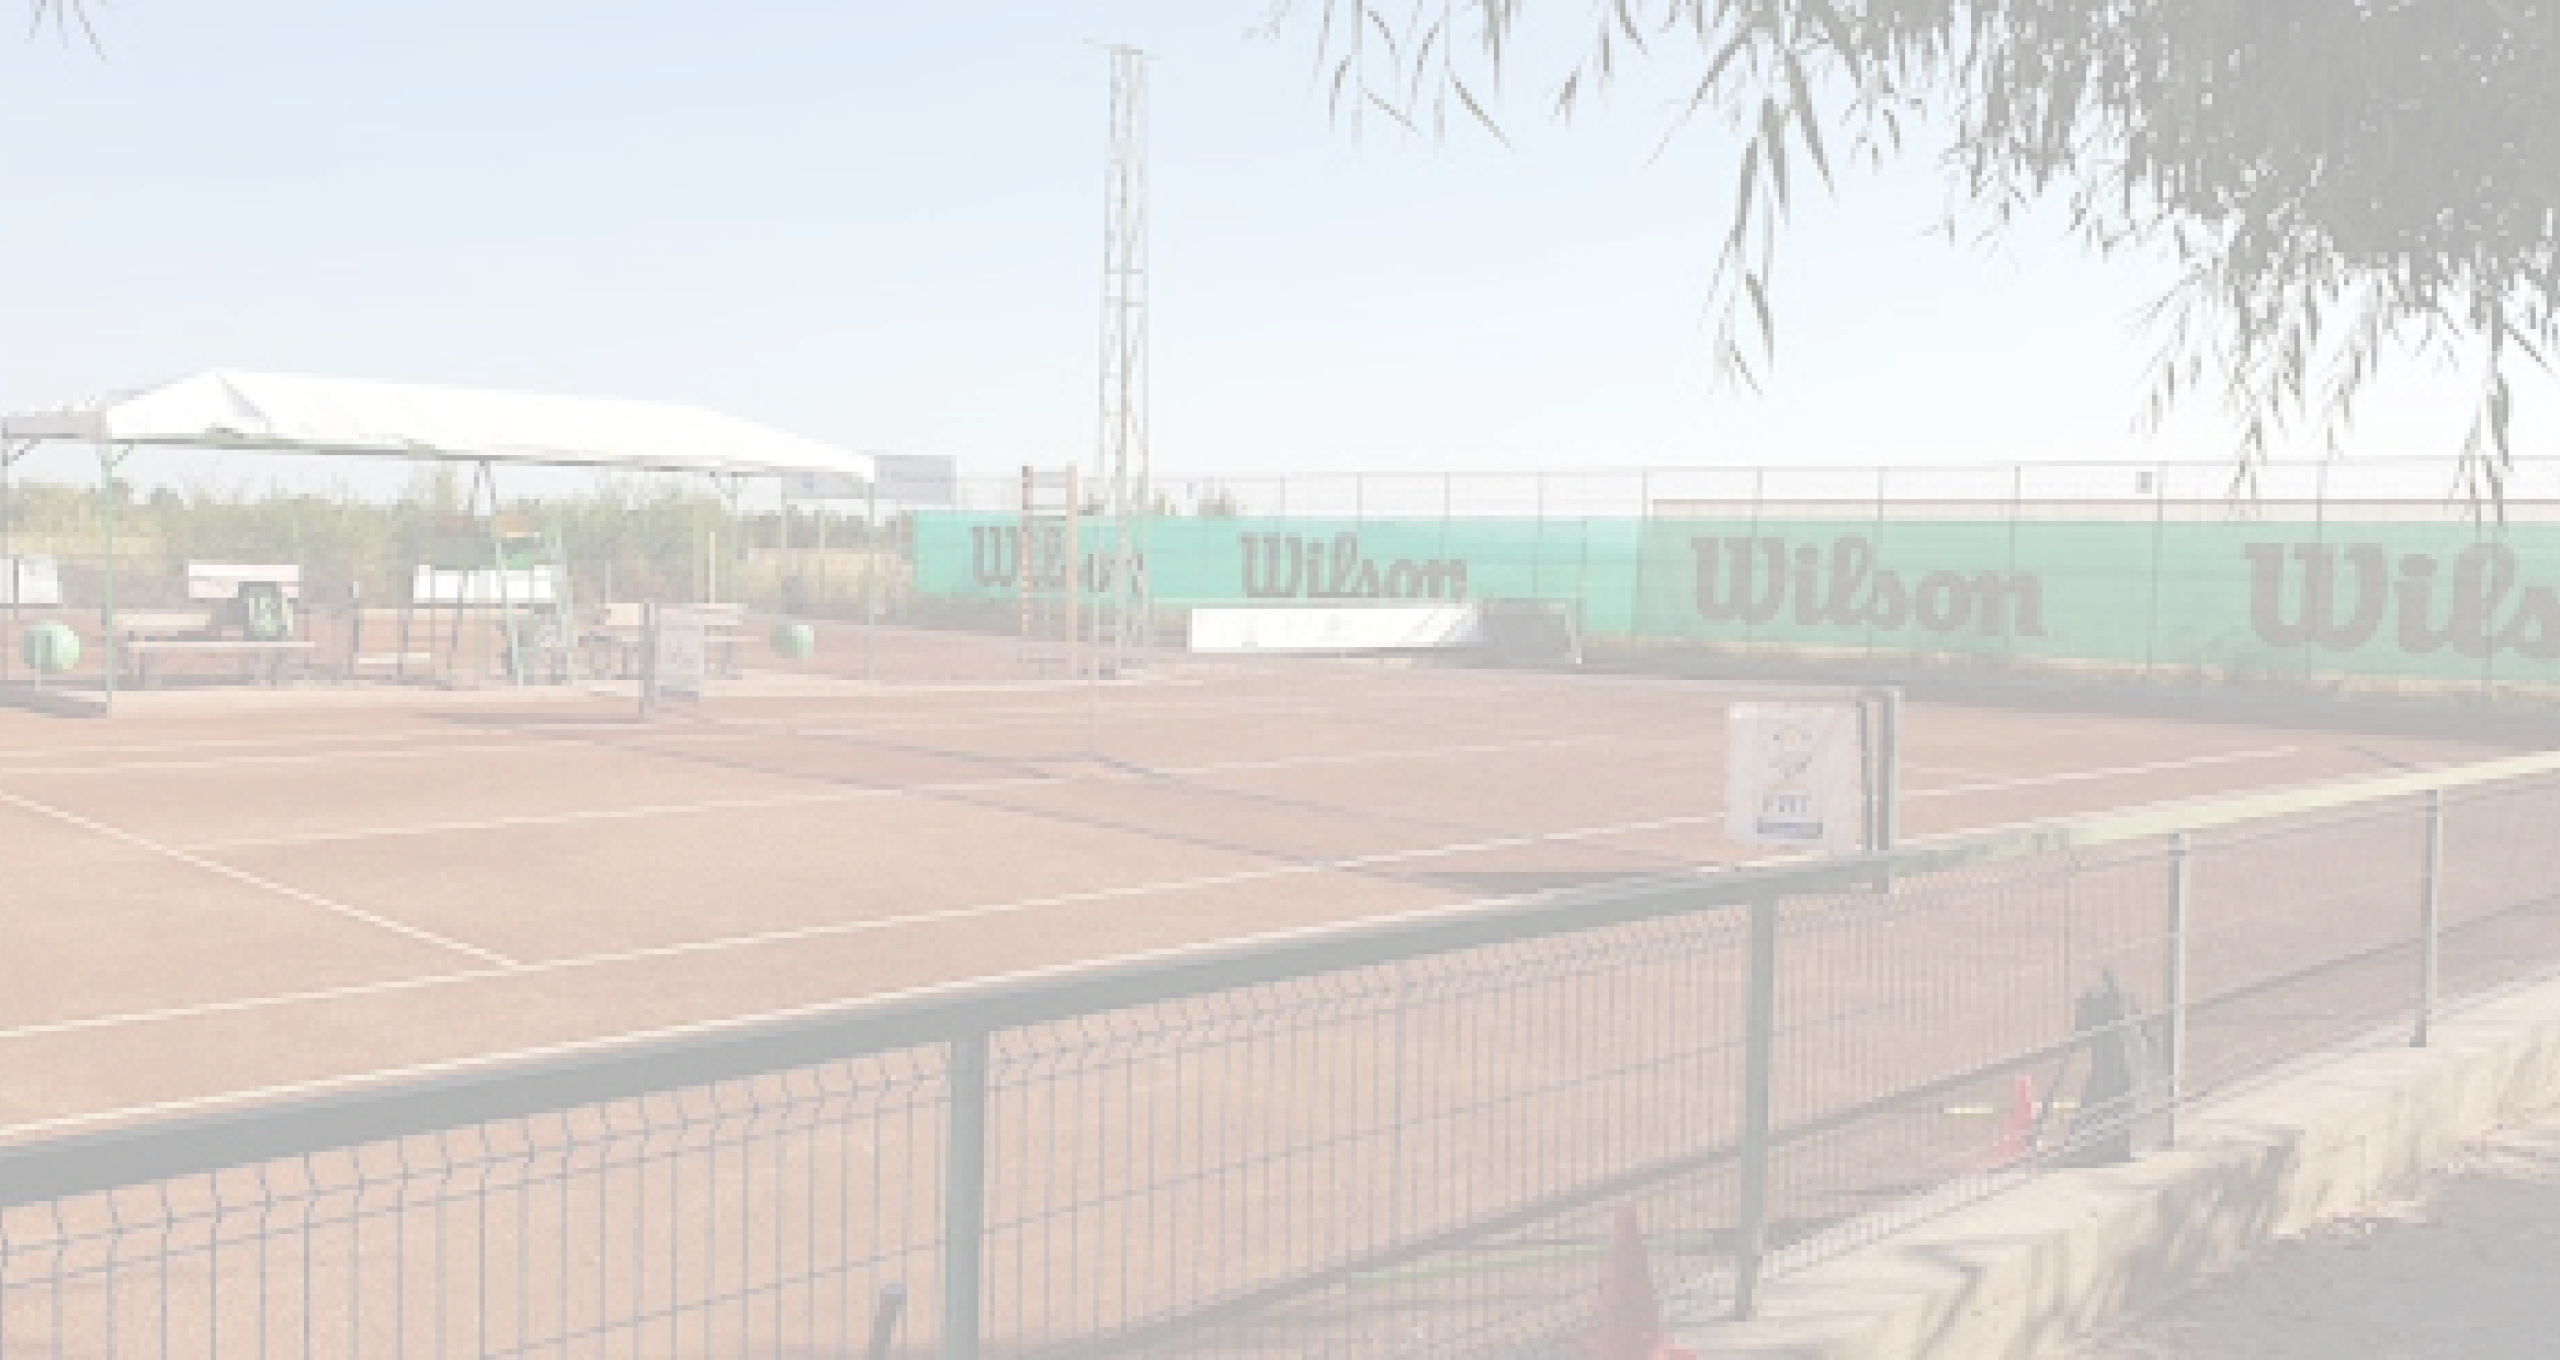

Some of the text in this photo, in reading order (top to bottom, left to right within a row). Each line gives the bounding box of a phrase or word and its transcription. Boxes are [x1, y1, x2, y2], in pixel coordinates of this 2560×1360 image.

[969, 525, 1144, 599] Wlon
[1240, 530, 1467, 599] Wilson
[1691, 534, 2046, 636] Wilson
[2246, 541, 2560, 661] Wils
